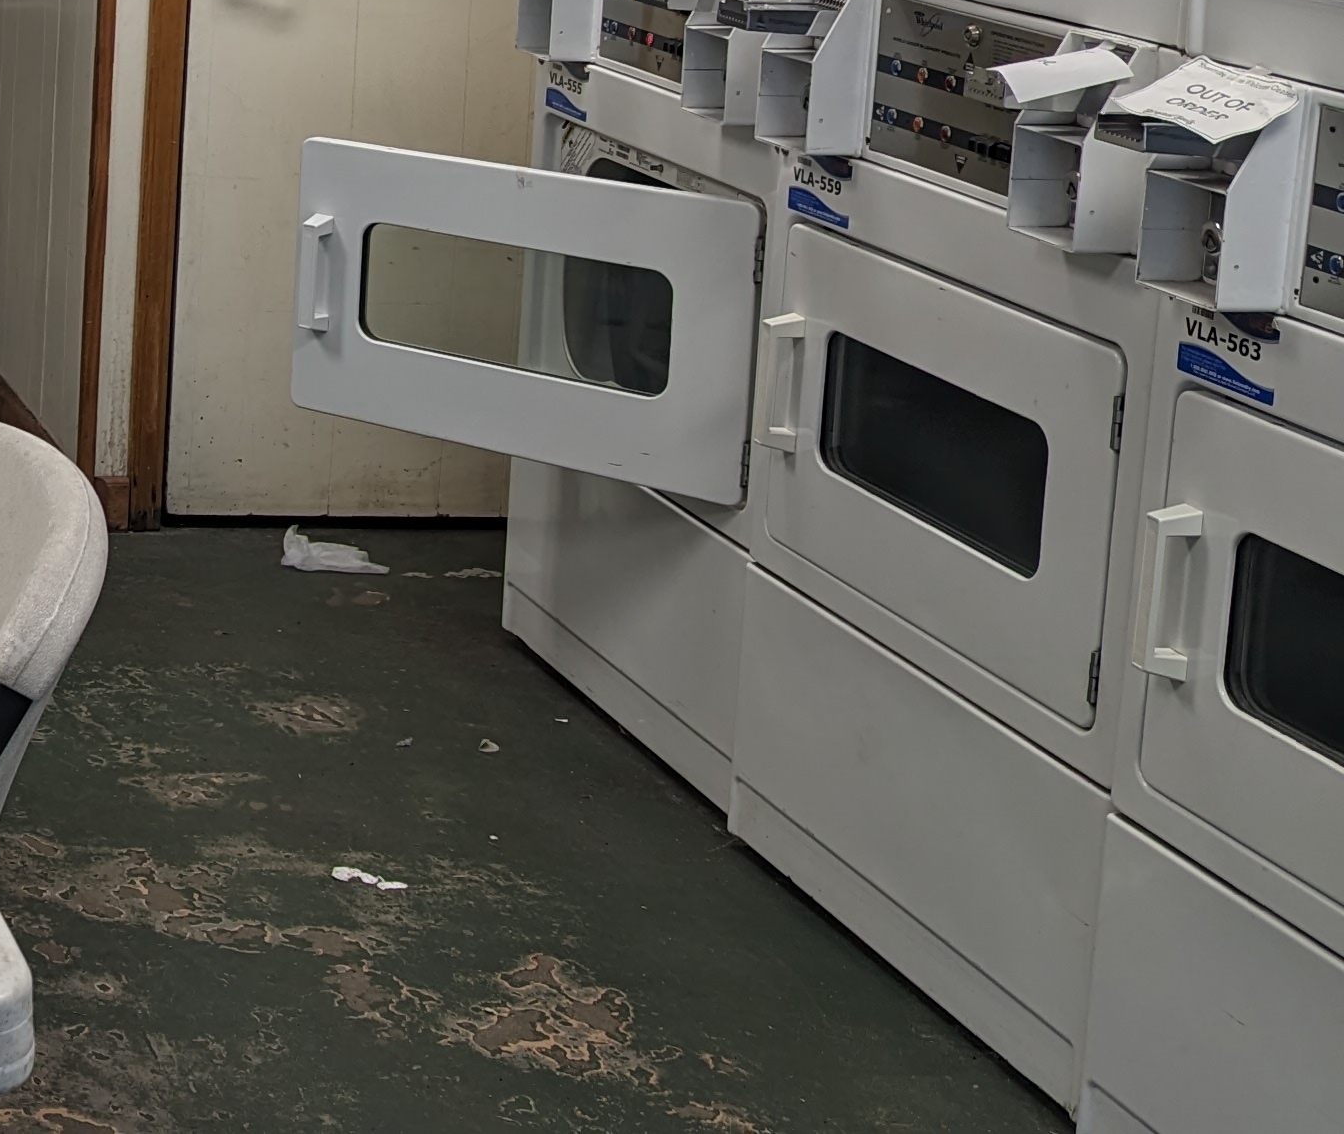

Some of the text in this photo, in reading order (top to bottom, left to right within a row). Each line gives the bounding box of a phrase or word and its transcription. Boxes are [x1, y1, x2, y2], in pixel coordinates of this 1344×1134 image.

[549, 70, 582, 95] VLA-555
[1165, 97, 1230, 121] ORDER
[1186, 84, 1256, 112] OUT OF
[793, 166, 842, 196] VLA-559
[1185, 316, 1262, 362] VLA-563
